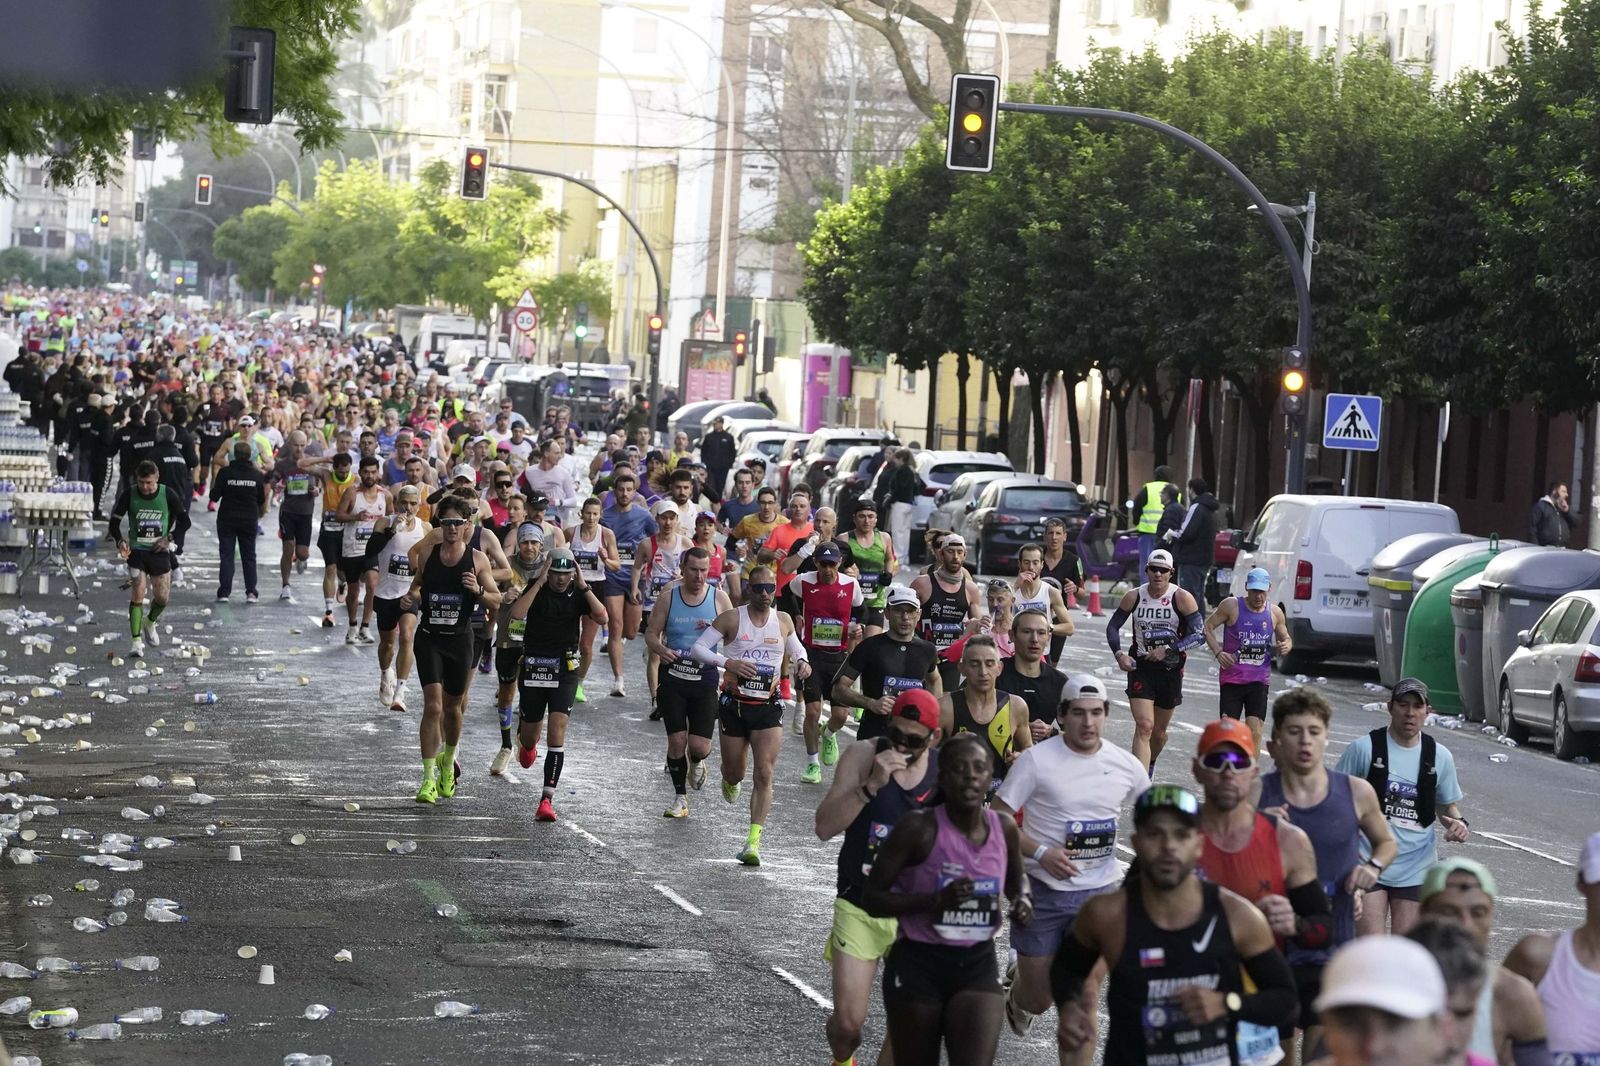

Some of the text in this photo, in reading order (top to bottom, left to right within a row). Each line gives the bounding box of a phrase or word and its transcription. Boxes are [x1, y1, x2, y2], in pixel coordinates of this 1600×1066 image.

[519, 315, 533, 325] 30
[133, 441, 155, 449] VOLUNTE
[226, 479, 257, 487] VOLUNTEER
[1328, 596, 1351, 606] 9177
[431, 610, 460, 618] DE DIEGO
[1137, 607, 1172, 619] UNED
[935, 638, 956, 647] CARLO
[741, 649, 771, 660] AQA
[672, 663, 700, 675] THIERRY
[531, 673, 553, 681] PABLO
[744, 681, 765, 690] KEITH
[1085, 821, 1113, 831] ZURICH
[1067, 845, 1113, 860] OMINGUEZ
[941, 910, 990, 926] MAGALI
